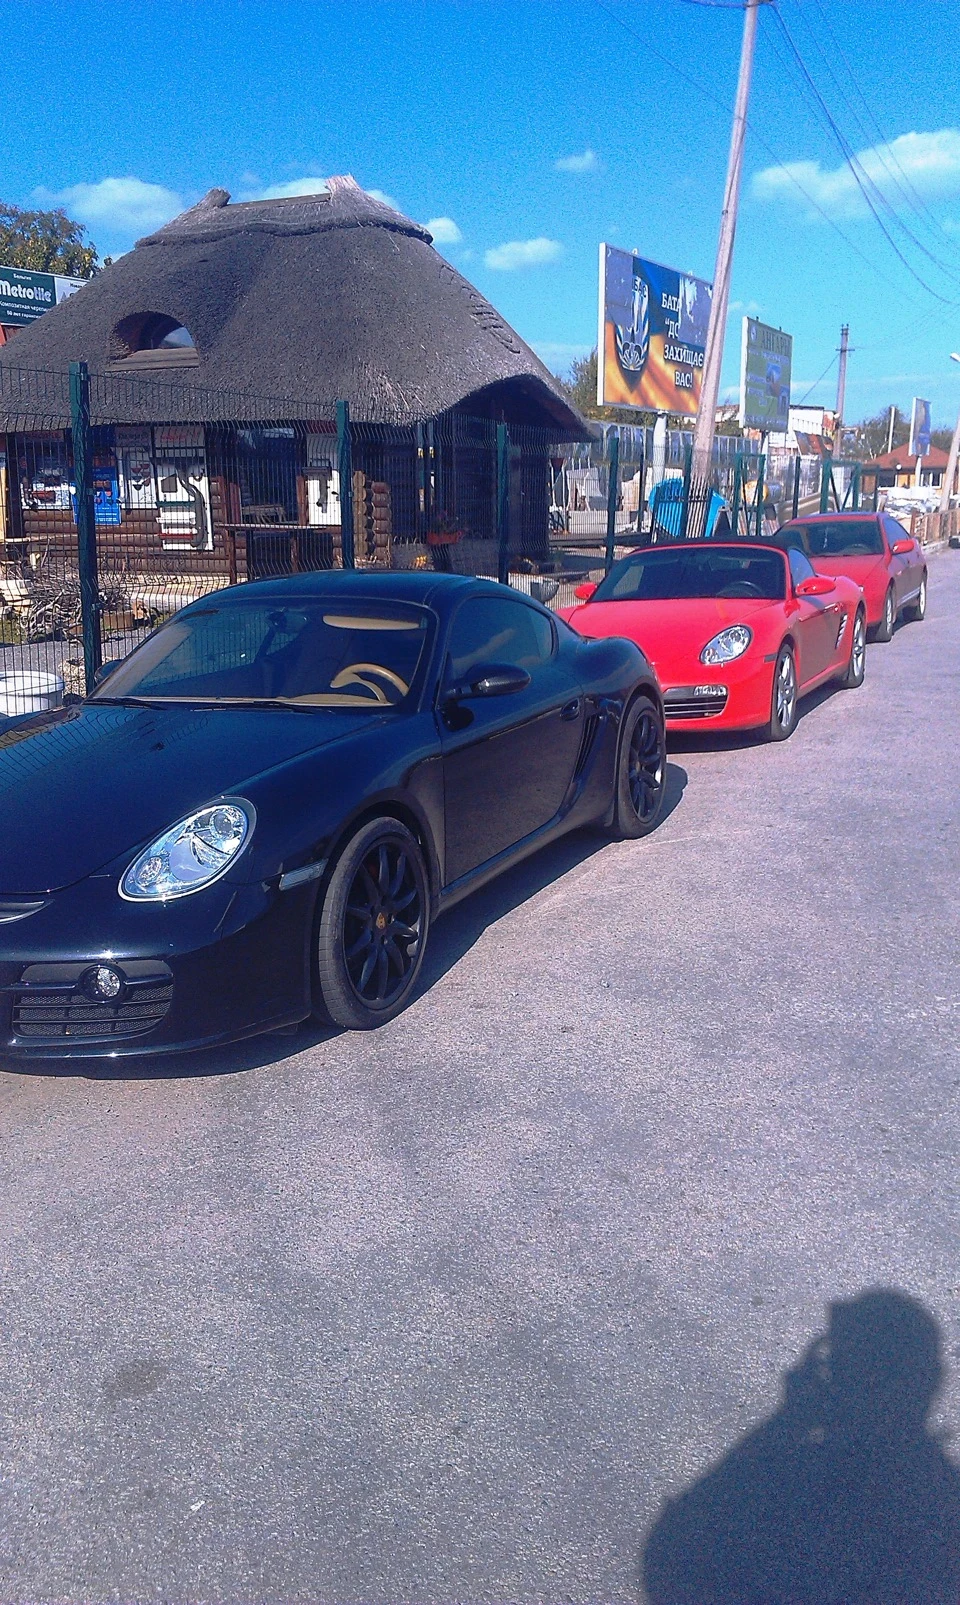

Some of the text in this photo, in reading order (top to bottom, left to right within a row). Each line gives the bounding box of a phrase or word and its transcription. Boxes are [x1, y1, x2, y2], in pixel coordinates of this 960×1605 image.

[0, 280, 51, 302] Metrotile
[664, 344, 704, 367] ЗАХИЩАЄ
[675, 371, 693, 388] ВАС!
